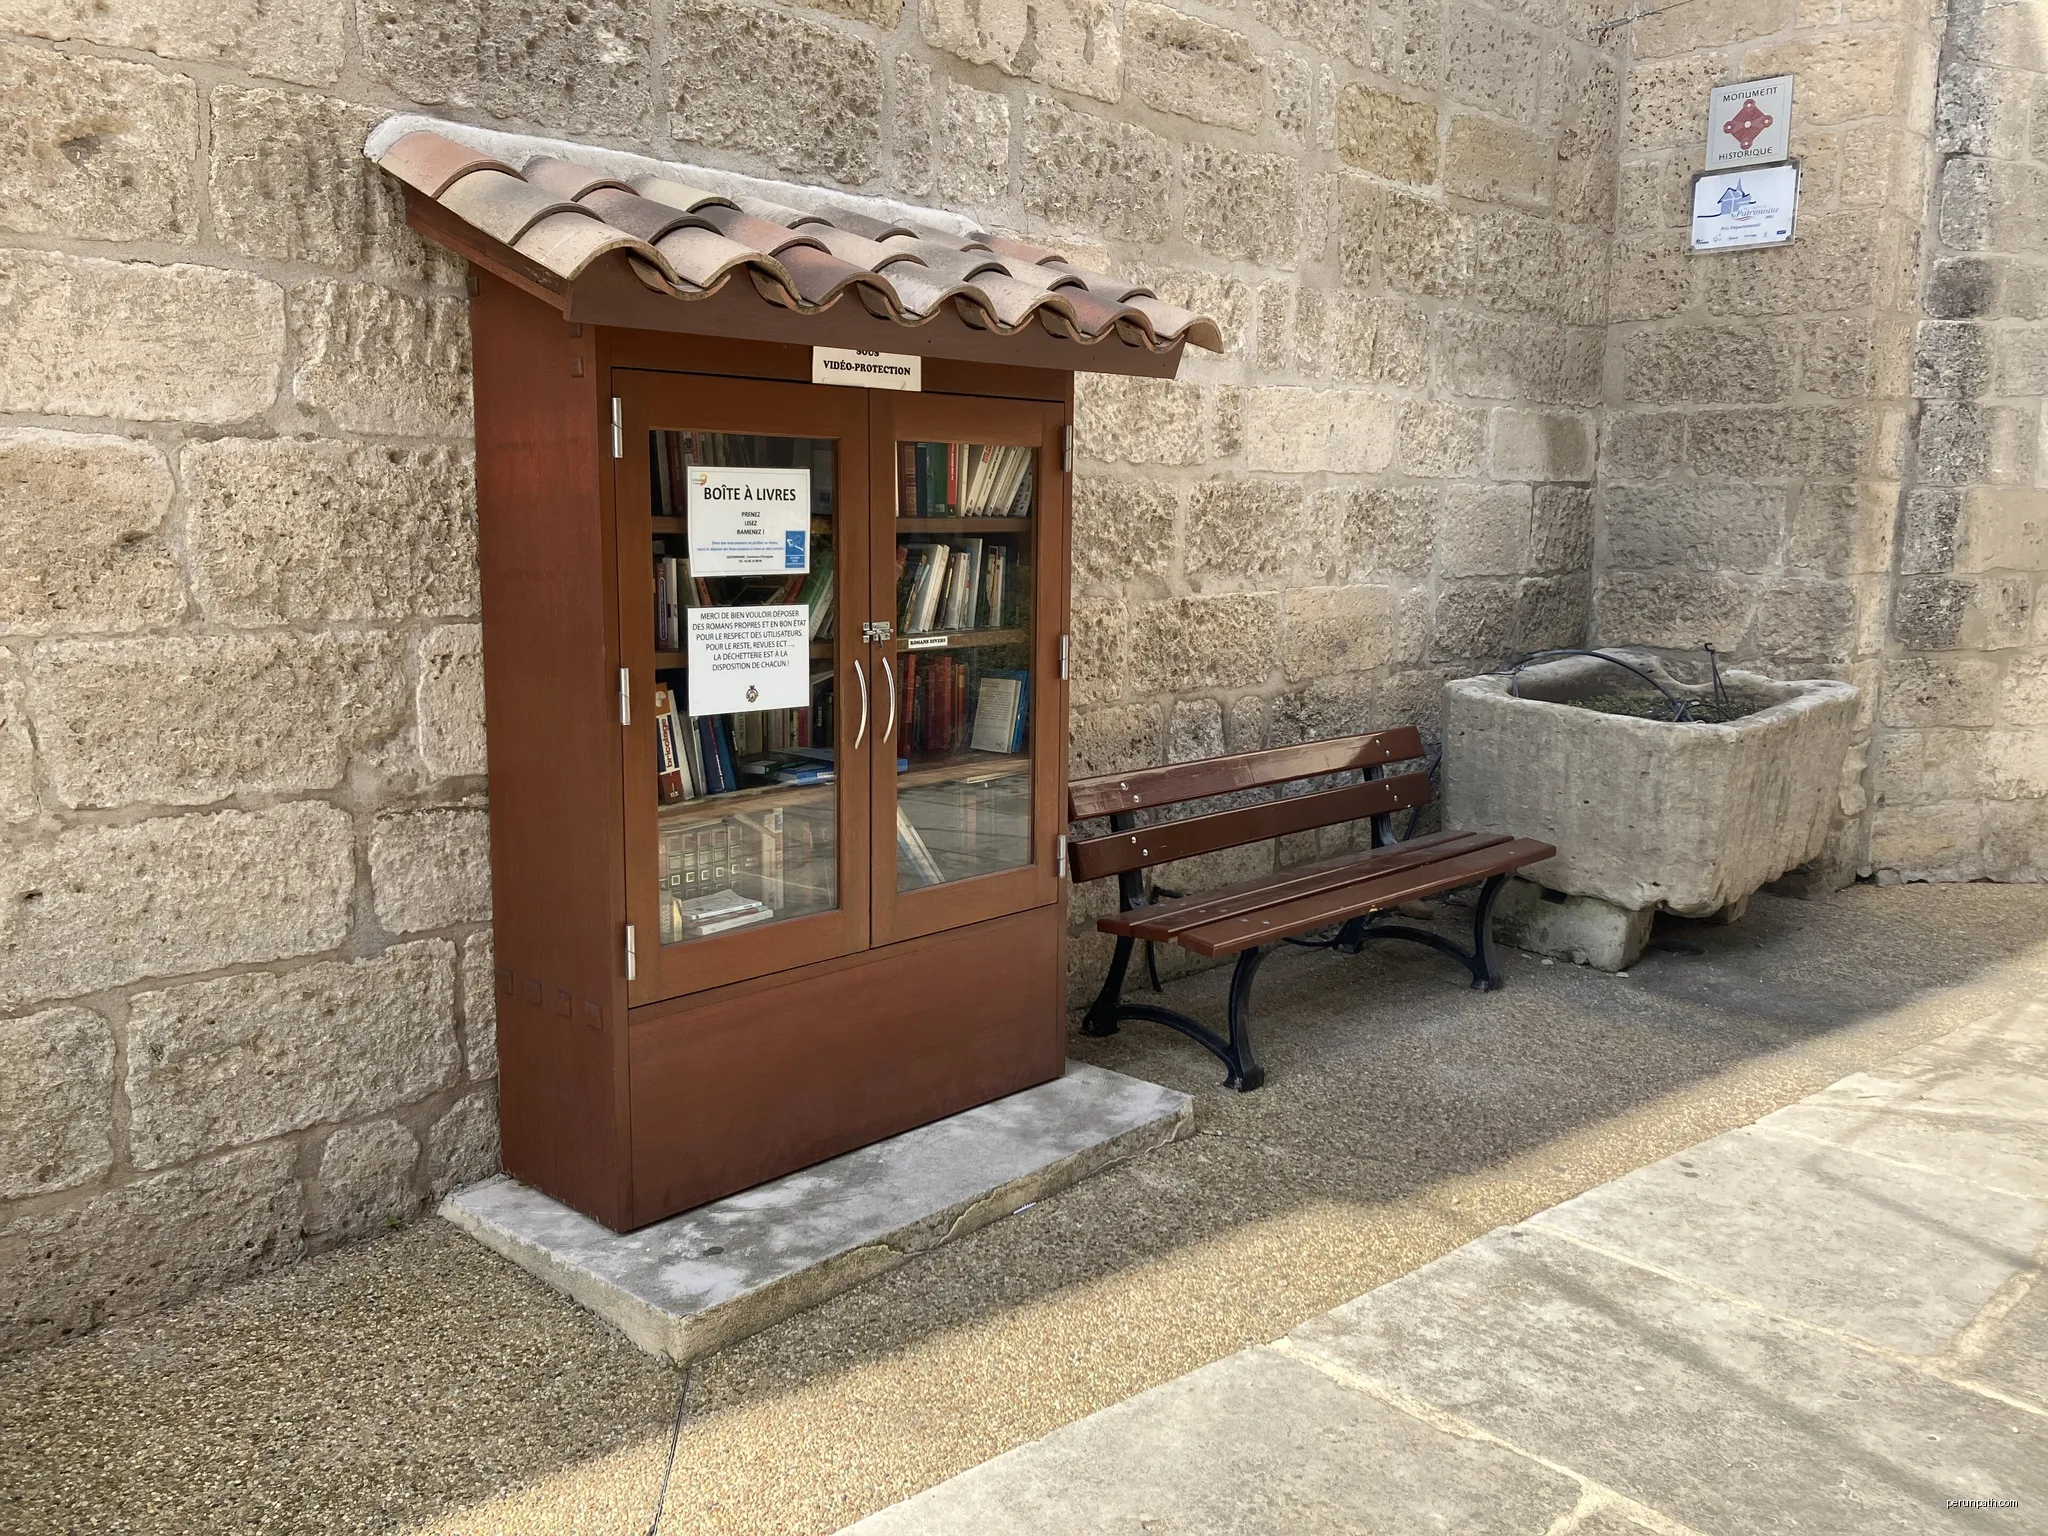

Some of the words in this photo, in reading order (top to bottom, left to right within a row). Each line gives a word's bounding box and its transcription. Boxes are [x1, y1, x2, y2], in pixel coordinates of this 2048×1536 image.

[1722, 86, 1778, 102] MONUMENT
[1718, 147, 1773, 161] HISTORIQUE
[823, 360, 911, 375] VIDÉO-PROTECTION
[704, 484, 741, 500] BOÎTE
[744, 485, 753, 500] À
[756, 488, 796, 501] LIVRES
[700, 612, 720, 620] MERCI
[731, 611, 745, 619] BIEN
[746, 611, 772, 619] VOULOIR
[773, 610, 799, 618] DÉPOSER
[706, 622, 733, 630] ROMANS
[734, 621, 760, 629] PROPRES
[793, 619, 806, 627] ÉTAT
[696, 633, 714, 641] POUR
[724, 632, 749, 640] RESPECT
[706, 643, 723, 651] POUR
[733, 642, 752, 650] RESTE,
[714, 653, 721, 661] LA
[723, 652, 762, 660] DÉCHETTERIE
[712, 662, 751, 671] DISPOSITION
[661, 719, 673, 768] bricolage
